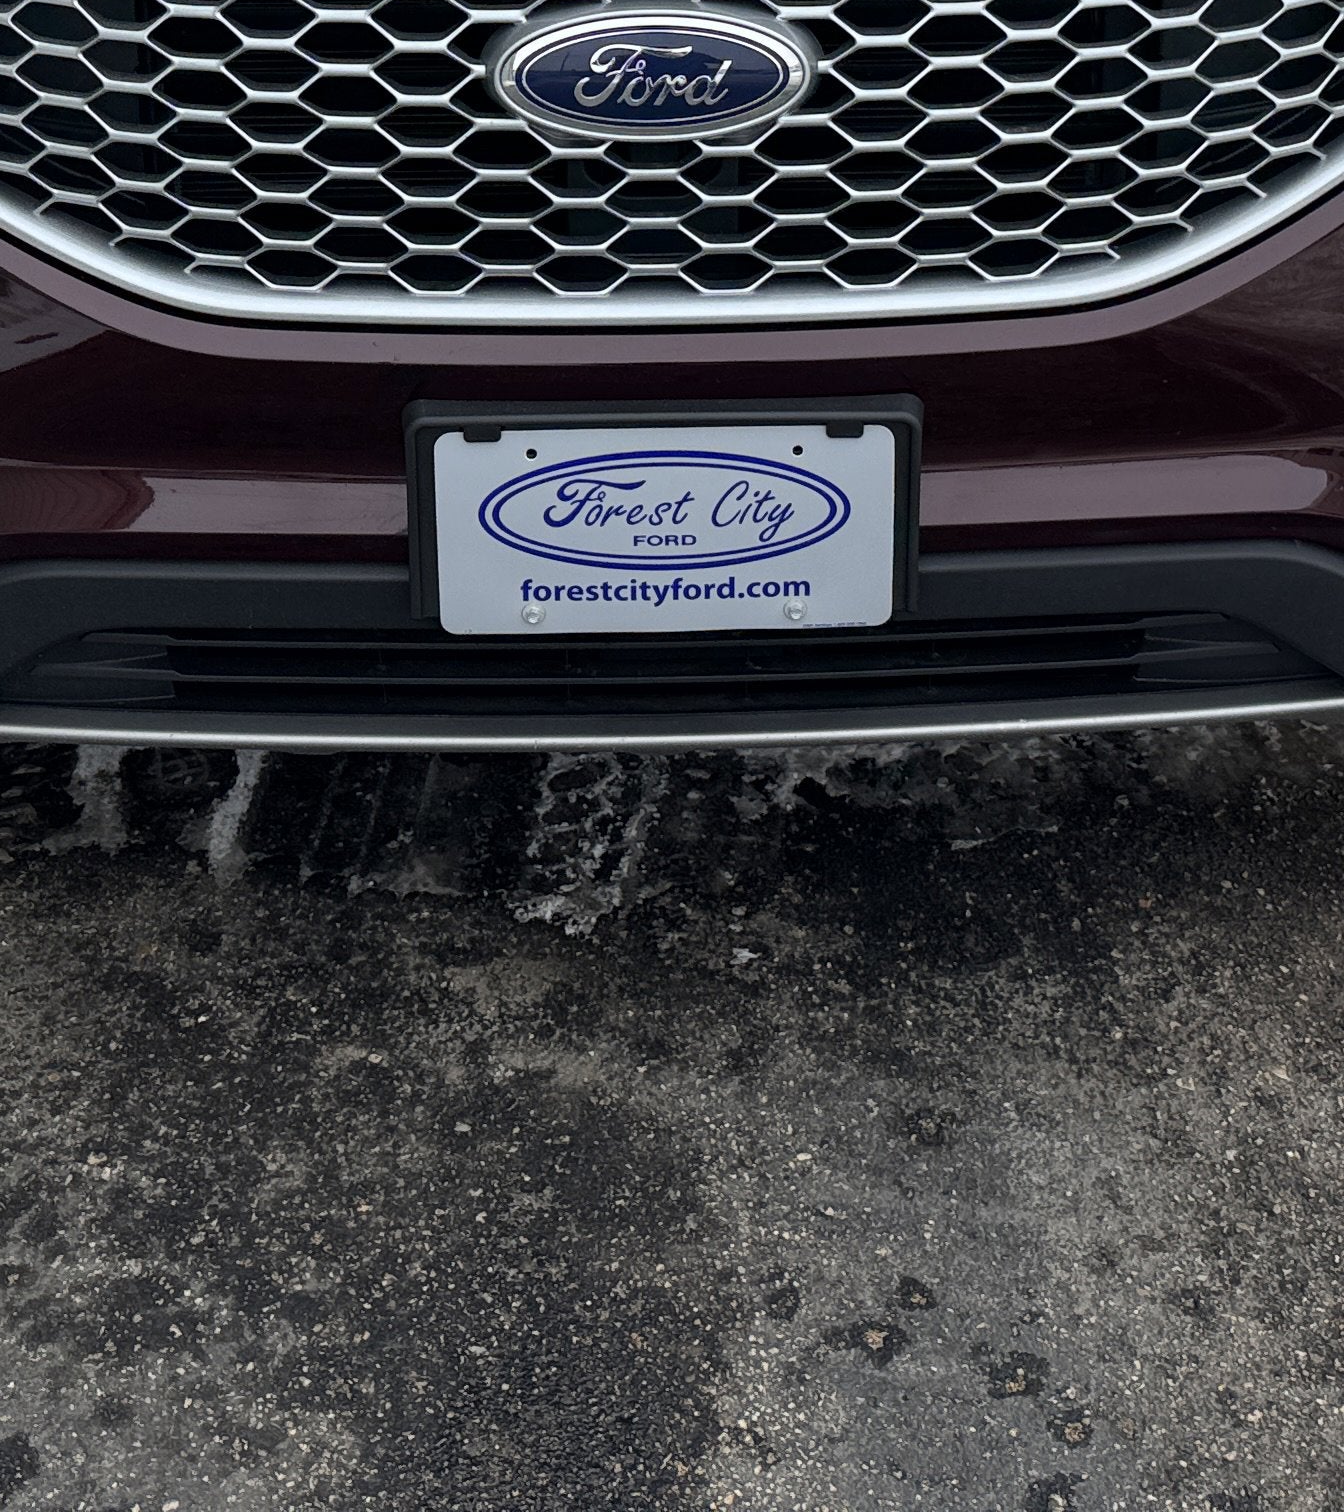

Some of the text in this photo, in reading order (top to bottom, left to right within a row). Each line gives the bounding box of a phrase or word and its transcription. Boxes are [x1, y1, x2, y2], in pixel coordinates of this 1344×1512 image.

[574, 43, 733, 107] Ford
[543, 478, 795, 542] Forest City
[632, 534, 698, 548] FORD
[520, 577, 812, 607] forestcityford.com
